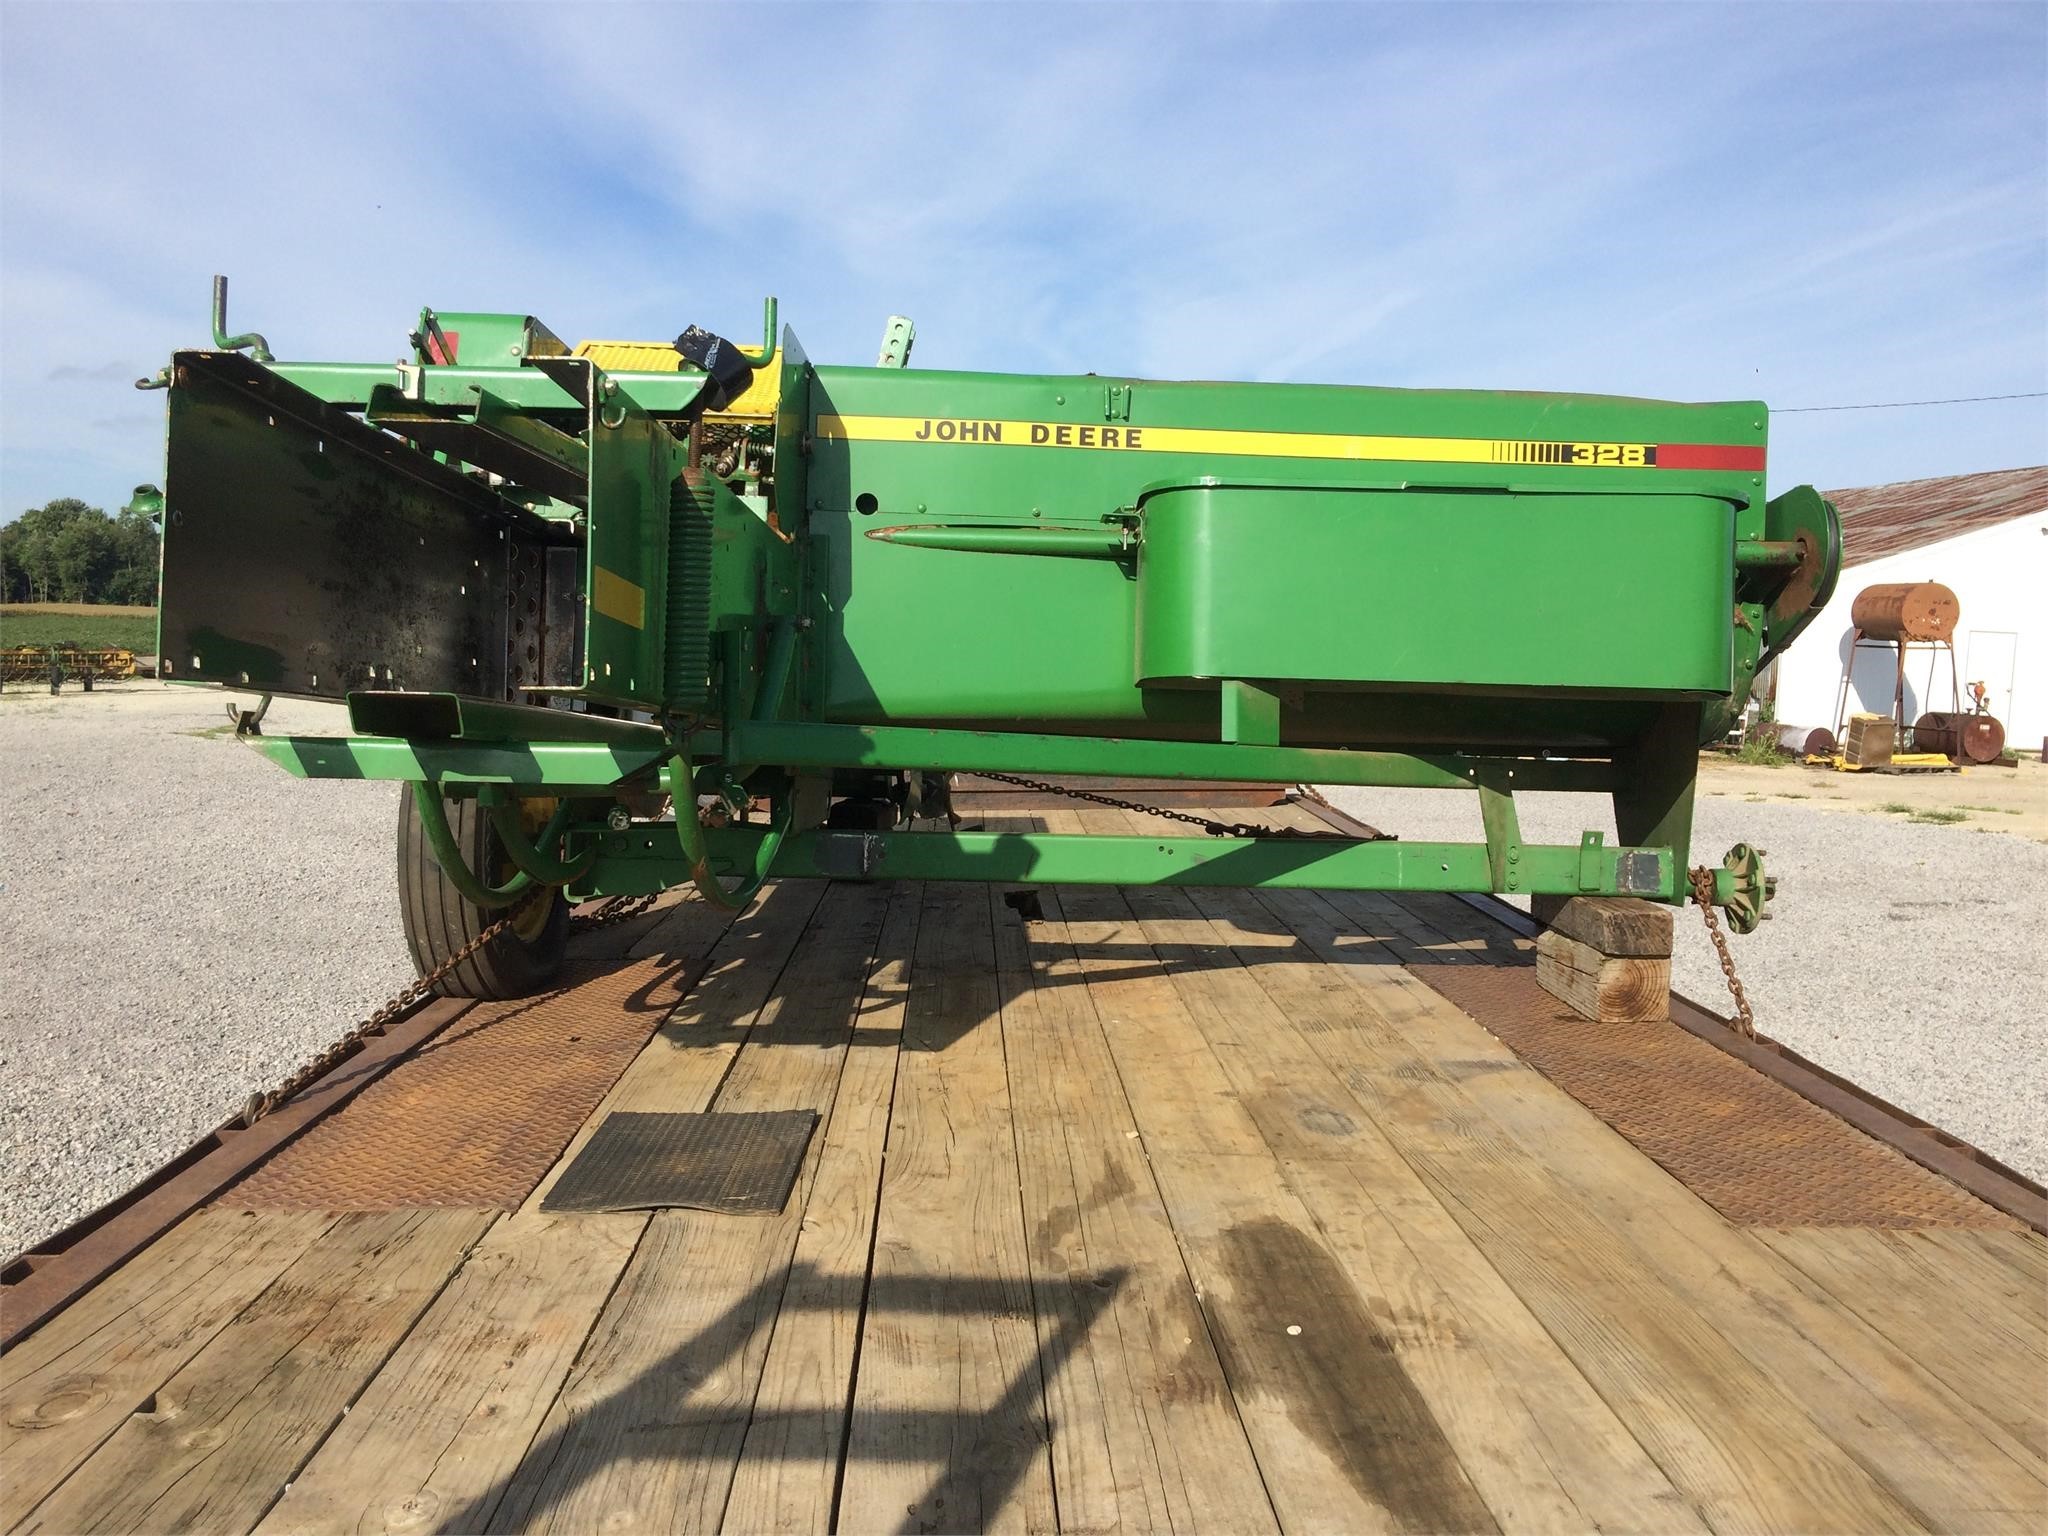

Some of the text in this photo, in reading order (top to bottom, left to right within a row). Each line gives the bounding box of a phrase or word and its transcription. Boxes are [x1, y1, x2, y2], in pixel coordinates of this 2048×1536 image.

[916, 421, 1142, 448] JOHN DEERE
[1572, 444, 1645, 465] 328
